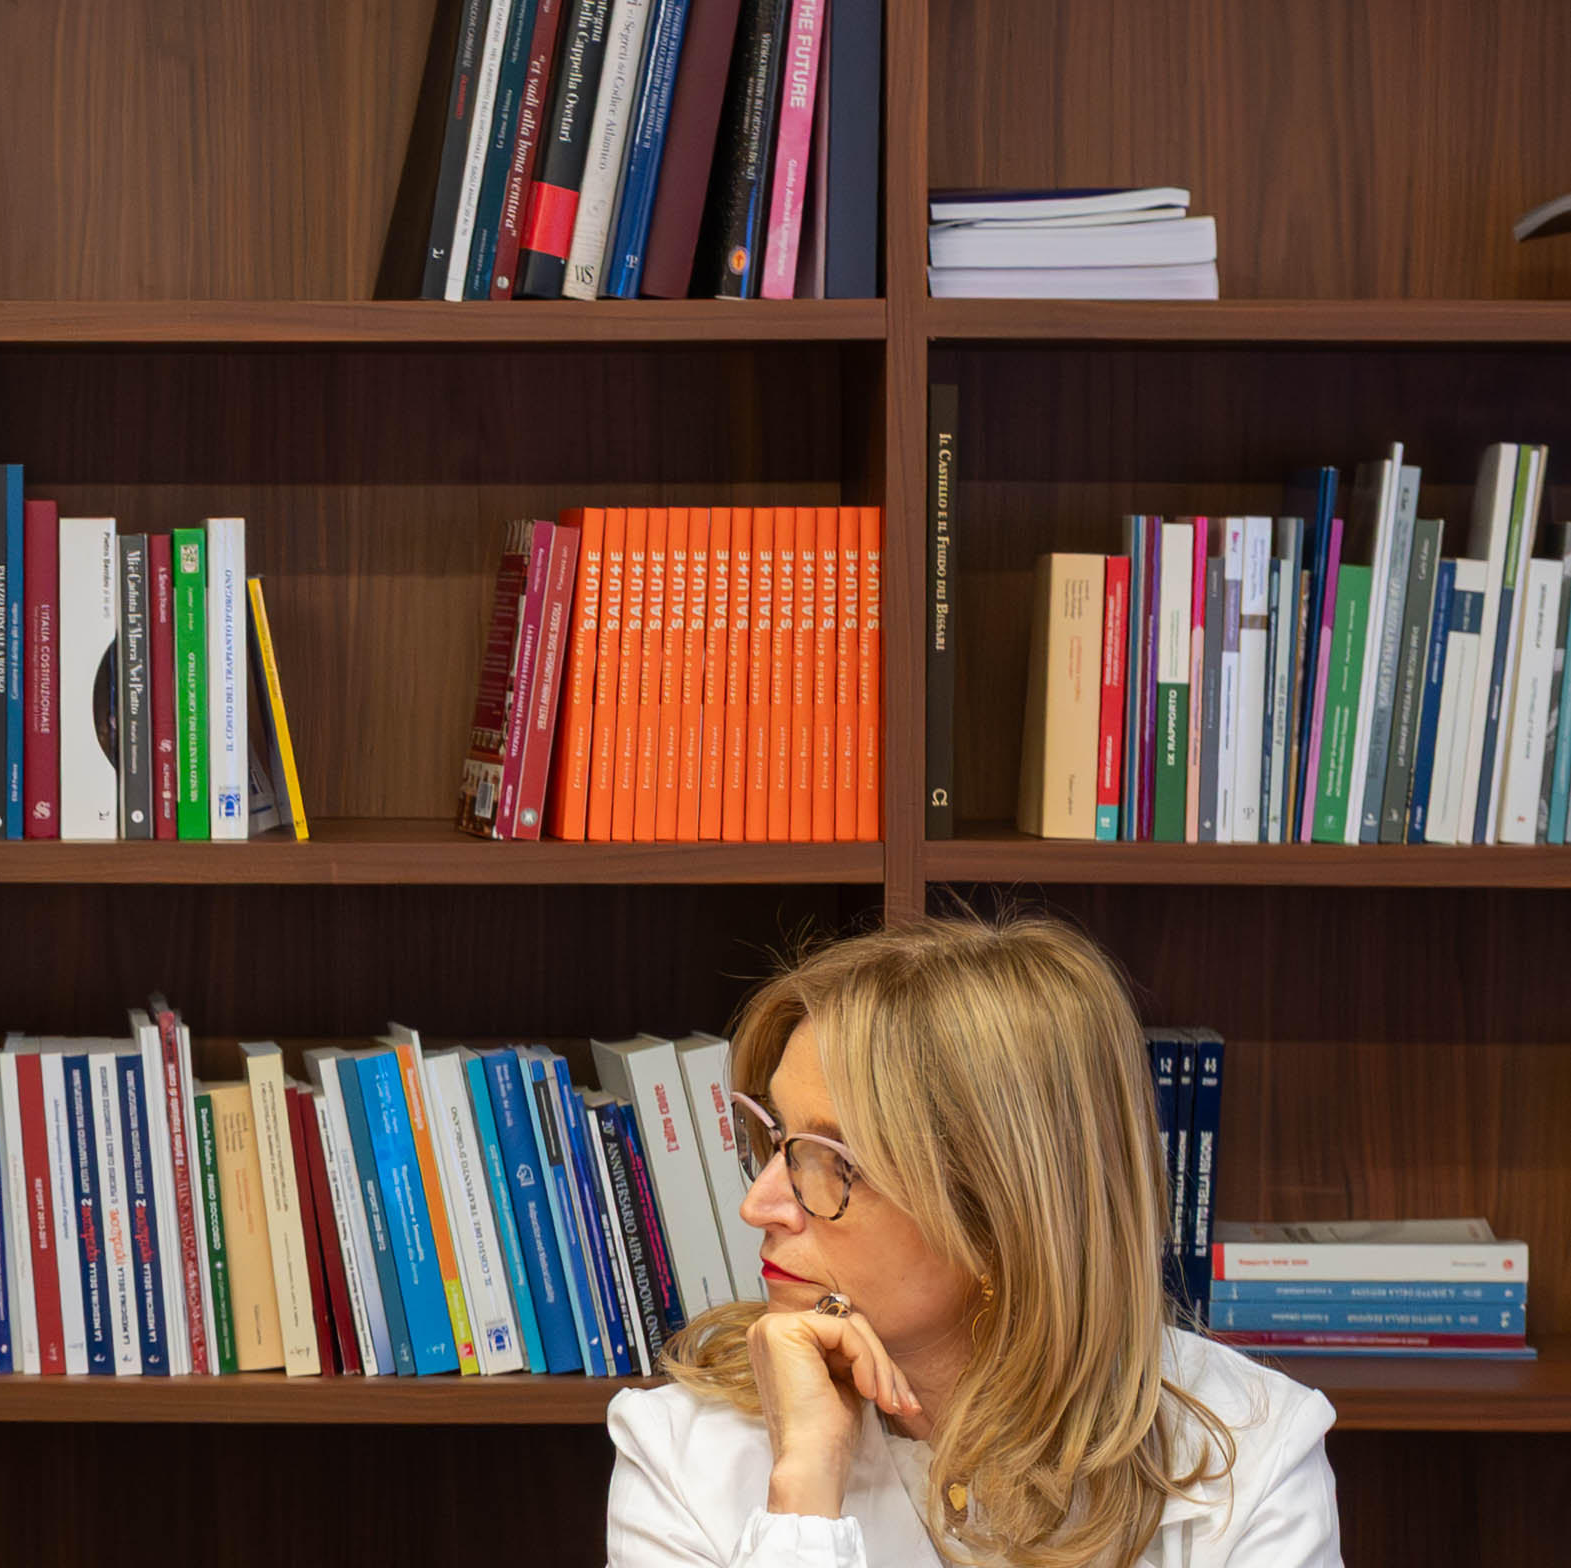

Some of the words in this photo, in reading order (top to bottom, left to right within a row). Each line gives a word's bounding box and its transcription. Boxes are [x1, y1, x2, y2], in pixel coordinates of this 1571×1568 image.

[790, 34, 811, 108] FUTURE
[524, 78, 541, 106] vadi
[519, 109, 535, 136] alla
[513, 139, 531, 173] bona
[40, 645, 50, 734] COSTITUZIONALE
